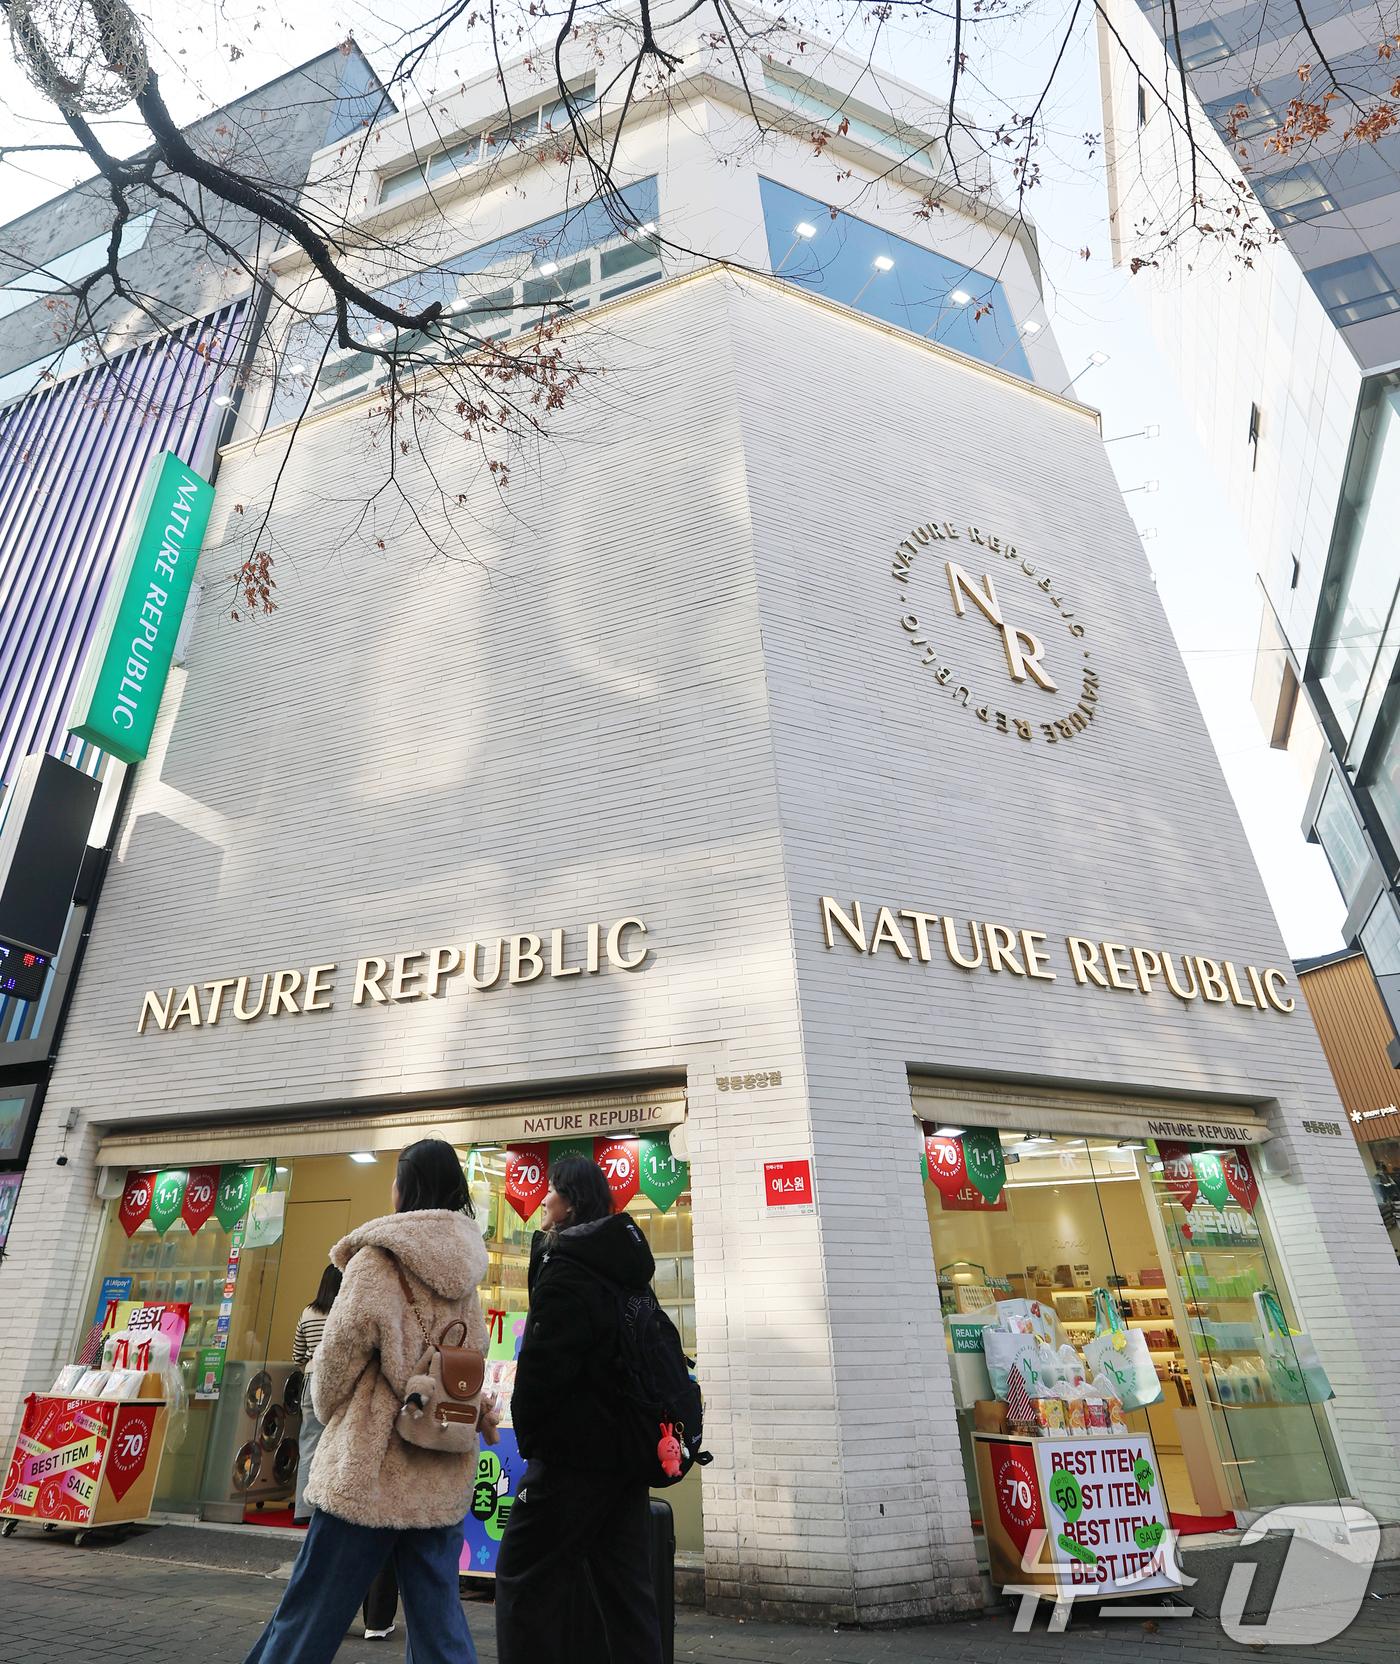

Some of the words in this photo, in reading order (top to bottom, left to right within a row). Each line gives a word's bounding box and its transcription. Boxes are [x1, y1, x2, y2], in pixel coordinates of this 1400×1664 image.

[154, 475, 198, 583] NATURE
[892, 521, 961, 584] NATURE
[968, 526, 1086, 638] REPUBLIC
[112, 582, 168, 729] REPUBLIC
[900, 613, 1034, 741] REPUBLIC
[1040, 667, 1100, 743] NATURE
[821, 895, 1057, 981] NATURE
[1066, 935, 1296, 1013] REPUBLIC
[137, 963, 338, 1034] NATURE
[352, 916, 651, 1006] REPUBLIC
[716, 1070, 782, 1092] 명동중앙점
[523, 1114, 583, 1133] NATURE
[588, 1106, 663, 1128] REPUBLIC
[1147, 1121, 1196, 1138] NATURE
[1198, 1124, 1252, 1140] REPUBLIC
[649, 1155, 676, 1174] 1+1
[772, 1176, 804, 1192] 에스원
[128, 1306, 167, 1324] BEST
[956, 1328, 974, 1338] REAL
[958, 1340, 980, 1349] MASK
[57, 1420, 74, 1434] PICK
[31, 1454, 60, 1476] BEST
[62, 1444, 89, 1466] ITEM
[1051, 1450, 1097, 1476] BEST
[1102, 1448, 1144, 1474] ITEM
[66, 1475, 94, 1500] SALE
[1136, 1466, 1152, 1482] PICK
[14, 1487, 34, 1502] SALE
[1081, 1484, 1104, 1510] ST
[1108, 1482, 1152, 1508] ITEM
[1064, 1519, 1110, 1546] BEST
[1140, 1528, 1160, 1544] SALE
[1070, 1555, 1118, 1584] BEST
[1122, 1550, 1167, 1580] ITEM
